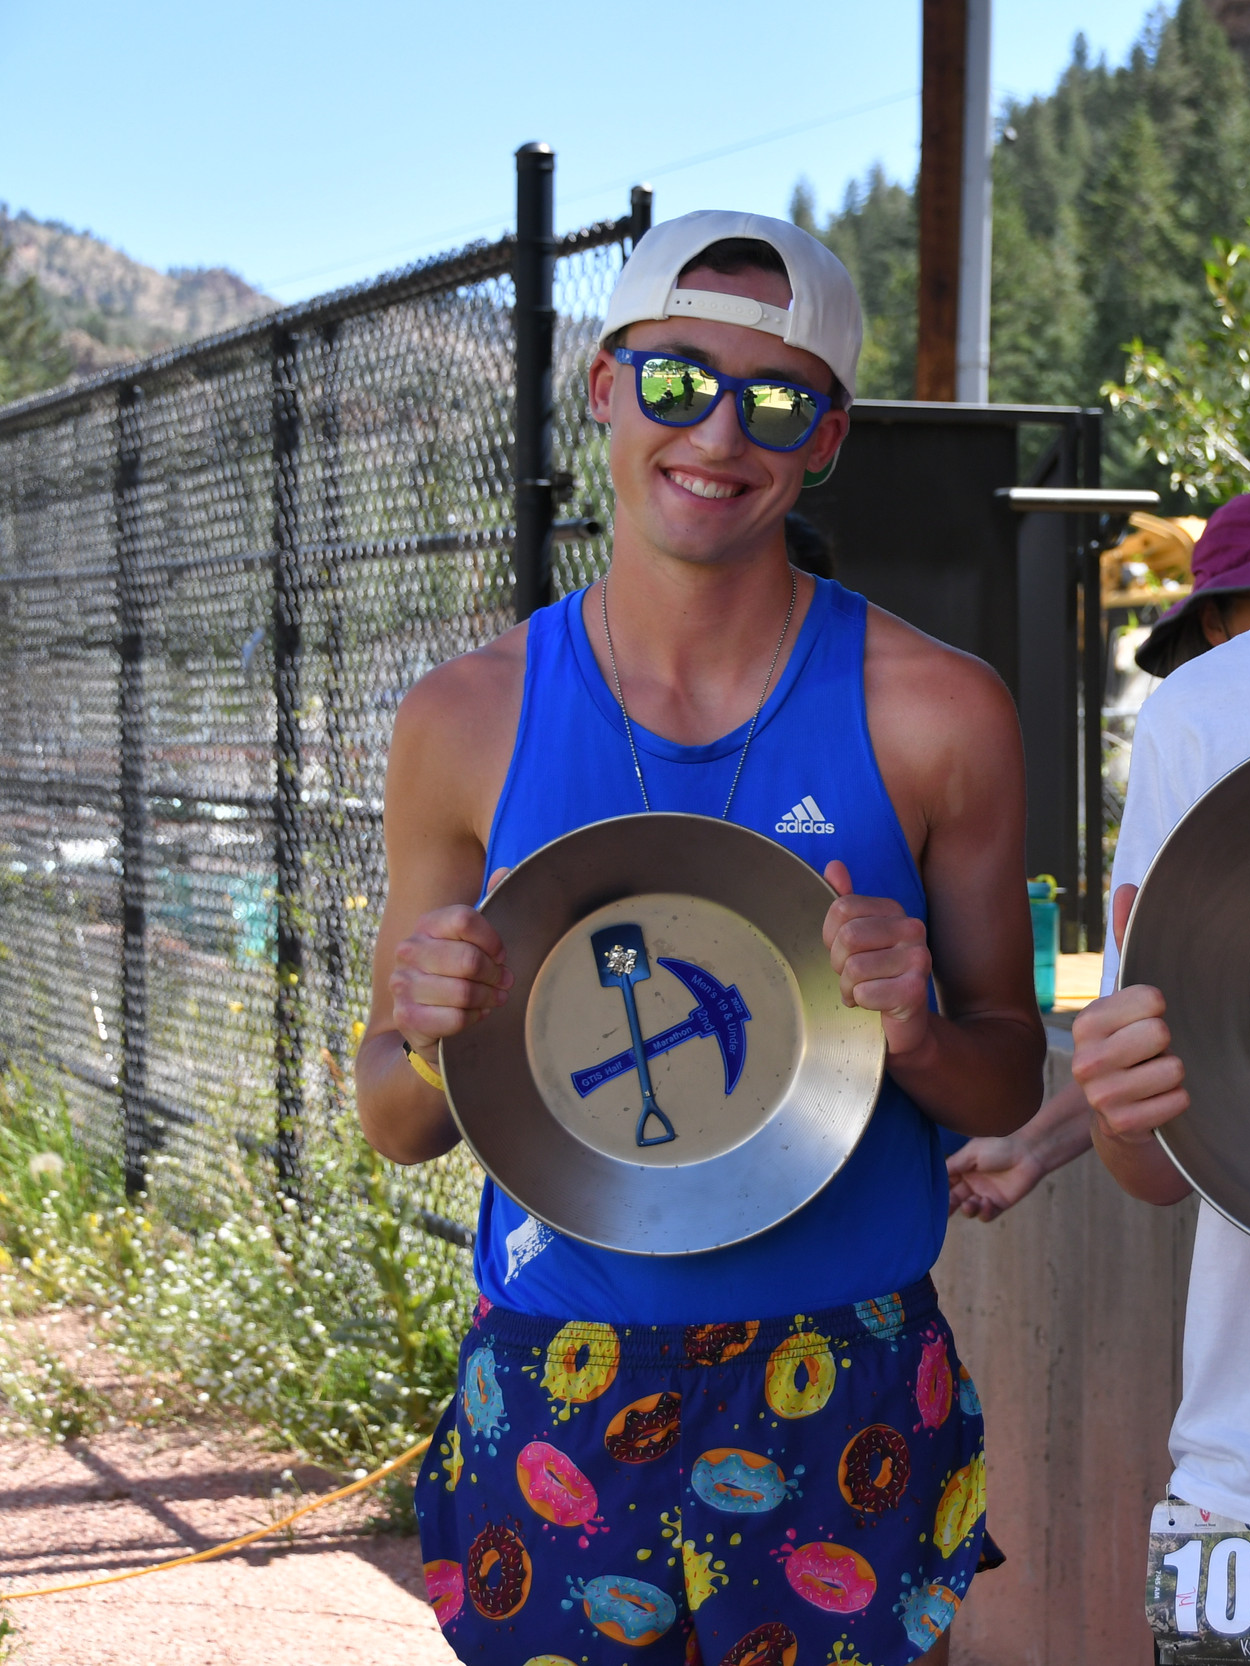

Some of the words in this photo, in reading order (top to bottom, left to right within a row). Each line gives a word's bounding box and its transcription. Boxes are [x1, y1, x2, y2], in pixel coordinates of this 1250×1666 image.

[775, 820, 835, 834] adidas
[691, 974, 717, 998] Men's
[717, 999, 728, 1011] 19
[727, 1022, 738, 1055] Under
[731, 997, 743, 1014] 2022
[697, 1009, 715, 1031] 2nd
[581, 1071, 603, 1087] GTIS
[605, 1061, 623, 1076] Half
[652, 1026, 692, 1051] Marathon
